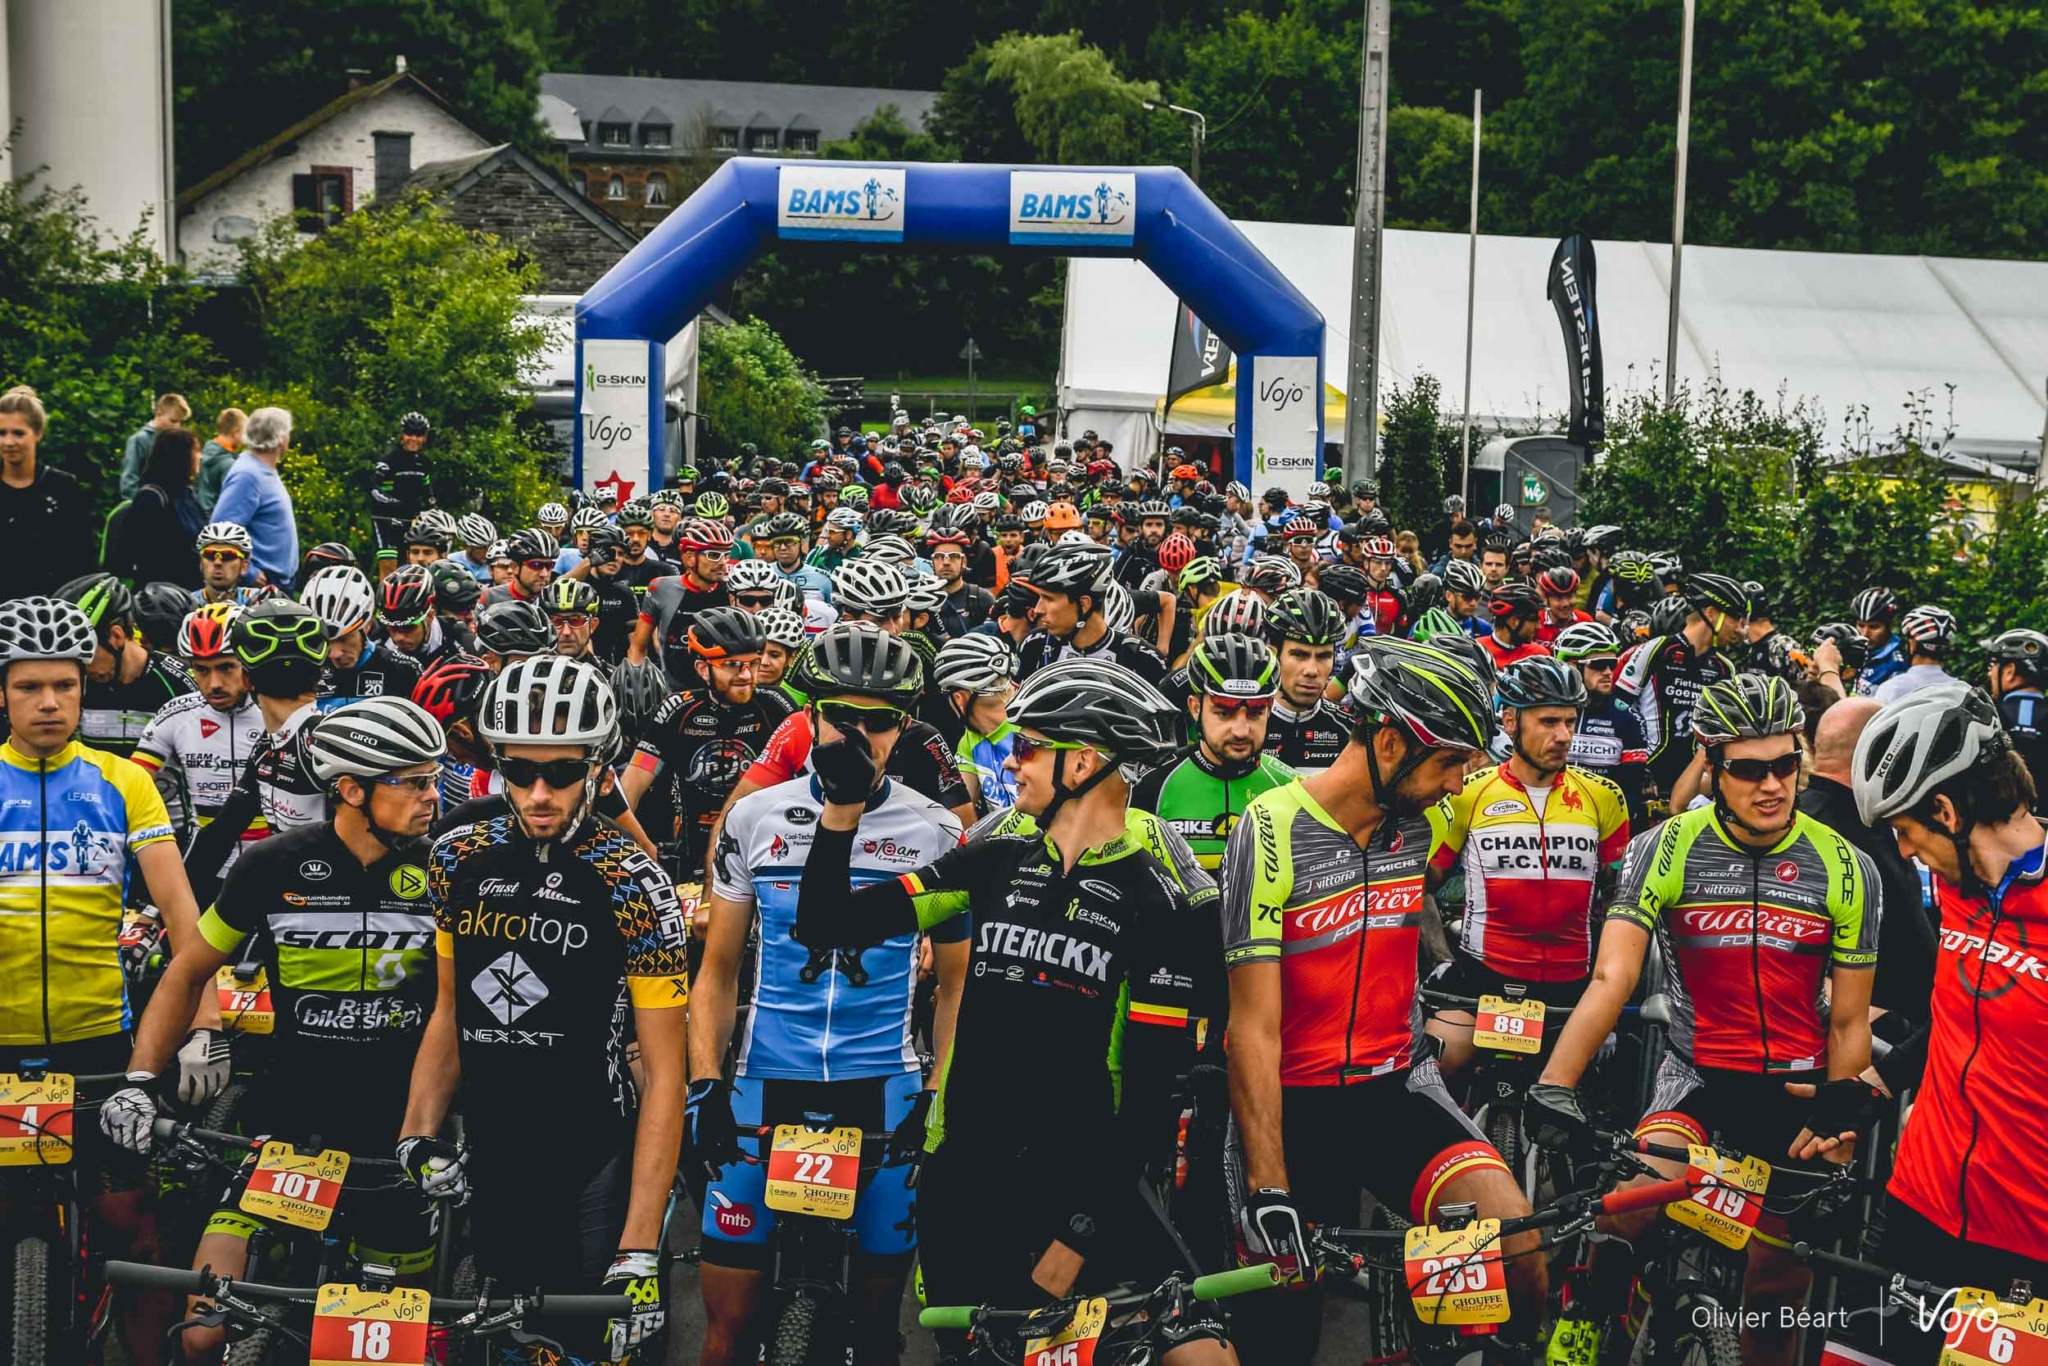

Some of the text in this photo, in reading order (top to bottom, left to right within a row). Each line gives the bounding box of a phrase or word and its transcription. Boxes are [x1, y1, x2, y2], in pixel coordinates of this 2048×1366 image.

[787, 188, 861, 215] BAMS
[1018, 193, 1094, 219] BAMS
[596, 374, 646, 384] G-SKIN
[1261, 377, 1304, 411] Vojo
[589, 415, 632, 450] Vojo
[1267, 457, 1314, 467] G-SKIN
[364, 684, 384, 696] 20
[350, 731, 378, 746] GIRO
[1313, 731, 1338, 740] Belfius
[185, 753, 213, 764] TEAM
[1194, 750, 1215, 771] BMC
[1876, 752, 1894, 779] KED
[1173, 820, 1214, 834] BIKE
[1258, 803, 1279, 885] Wilier
[1480, 835, 1598, 853] CHAMPION
[1657, 814, 1683, 878] Wilier
[1309, 858, 1351, 872] GAERNE
[1374, 858, 1419, 874] MICHE
[1498, 855, 1587, 871] F.C.W.B.
[1829, 833, 1855, 907] FORCE
[1315, 869, 1357, 889] vittoria
[1698, 870, 1742, 878] GAERNE
[478, 878, 520, 896] Trust
[1087, 881, 1121, 901] SCHWALBE
[1703, 884, 1747, 895] vittoria
[1765, 889, 1818, 905] MICHE
[1295, 885, 1423, 932] Wilier
[457, 900, 589, 956] akrotop
[1078, 908, 1121, 934] G-SKIN
[1331, 913, 1404, 943] FORCE
[1683, 908, 1825, 938] Wilier
[1780, 914, 1826, 929] TRIESTINA
[975, 921, 1114, 982] STERCKX
[1719, 935, 1794, 951] FORCE
[1149, 977, 1172, 986] KBC
[229, 991, 257, 1011] 73
[302, 1008, 356, 1030] bike
[1522, 1010, 1541, 1020] Vojo
[1493, 1015, 1525, 1035] 89
[46, 1088, 70, 1103] Vojo
[19, 1105, 39, 1136] 4
[832, 1139, 857, 1155] Vojo
[317, 1165, 342, 1180] Vojo
[793, 1153, 834, 1186] 22
[1430, 1149, 1495, 1184] MICHE
[271, 1171, 322, 1203] 101
[1741, 1174, 1765, 1192] Vojo
[803, 1187, 850, 1202] CHOUFFE
[1691, 1174, 1748, 1218] 219
[280, 1199, 327, 1217] CHOUFFE
[720, 1212, 751, 1229] mtb
[1704, 1212, 1747, 1236] CHOUFFE
[1422, 1254, 1488, 1295] 235
[624, 1277, 661, 1306] 661
[1452, 1294, 1504, 1306] CHOUFFE
[393, 1302, 424, 1321] Vojo
[1454, 1302, 1504, 1312] Marathon
[1075, 1320, 1100, 1338] Vojo
[347, 1320, 392, 1361] 18
[1988, 1326, 2017, 1364] 6
